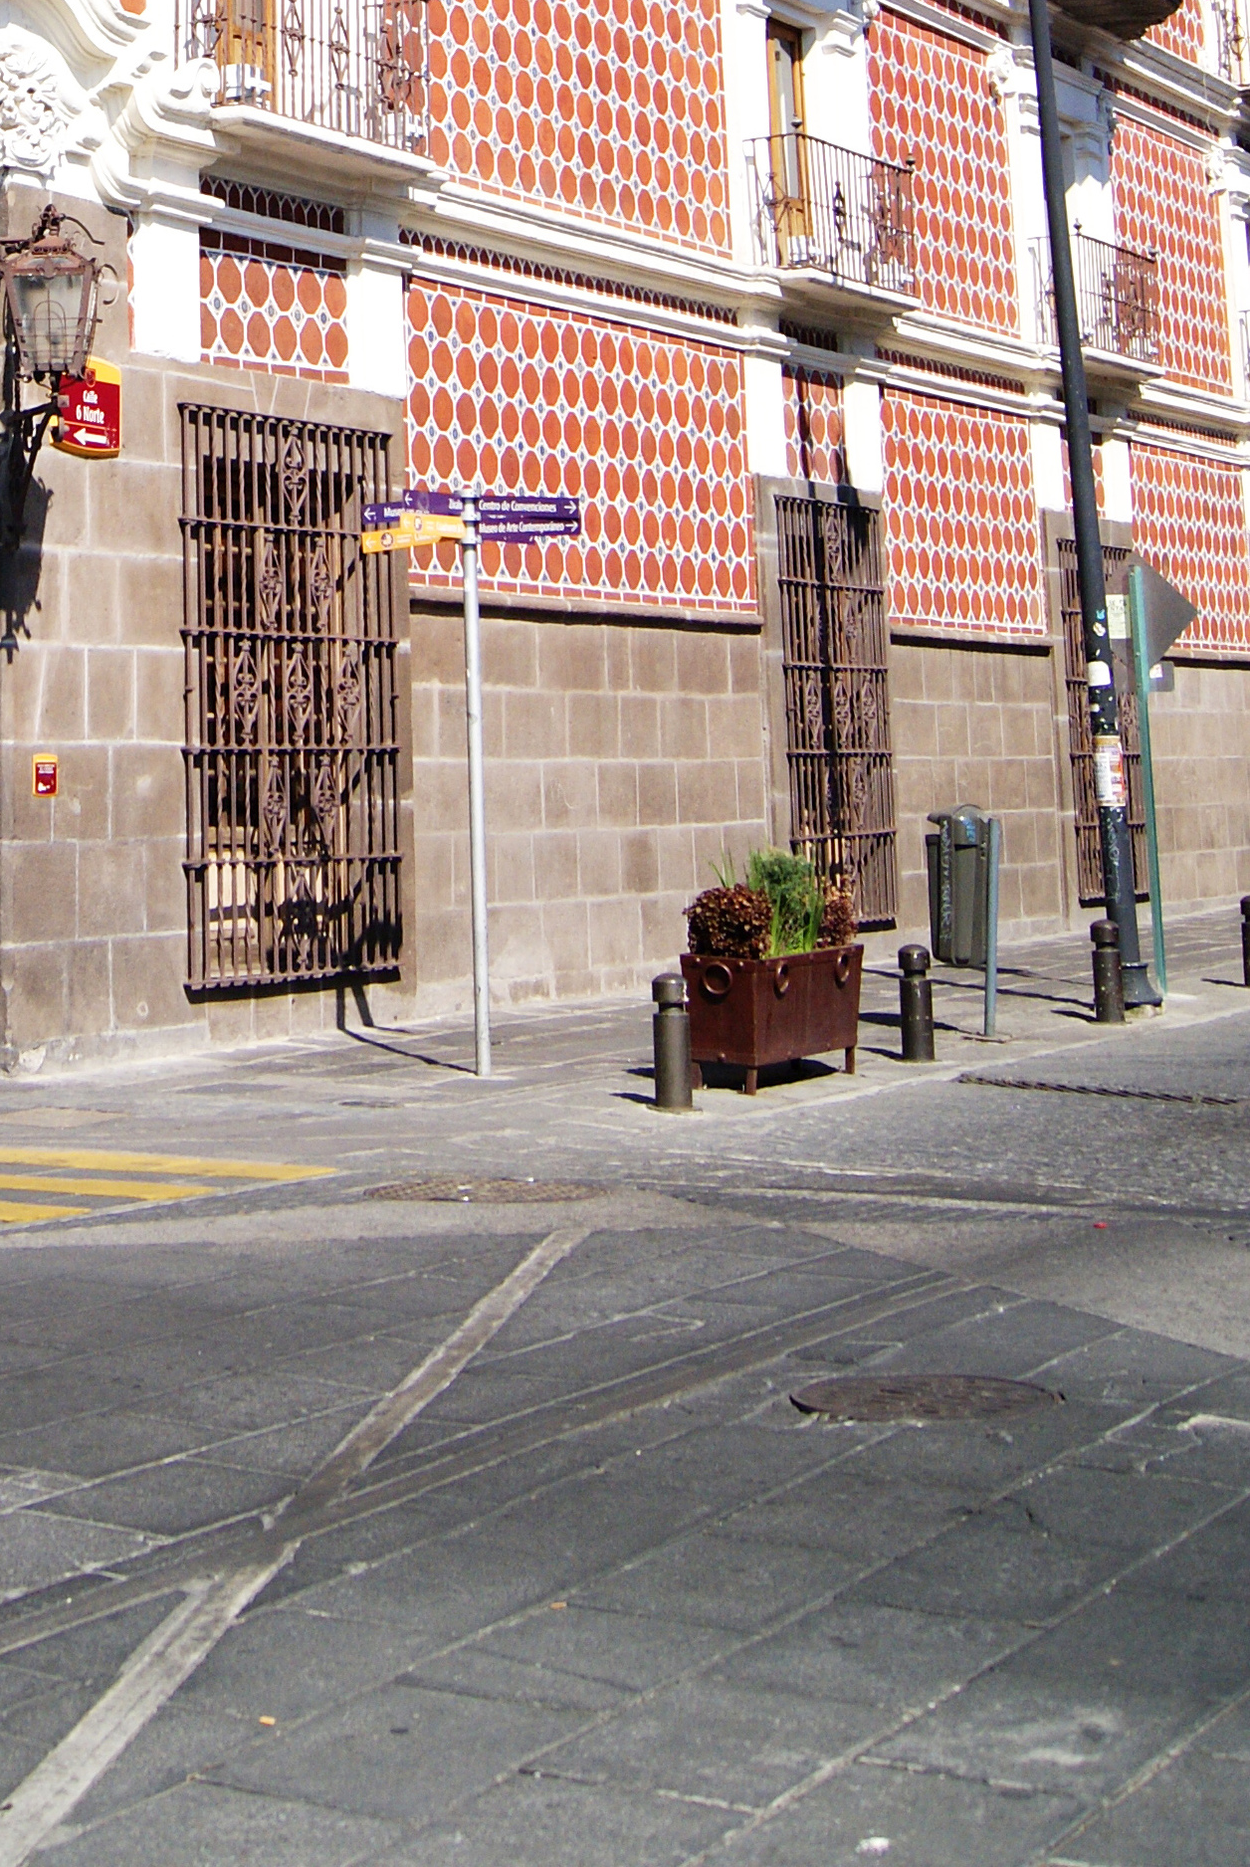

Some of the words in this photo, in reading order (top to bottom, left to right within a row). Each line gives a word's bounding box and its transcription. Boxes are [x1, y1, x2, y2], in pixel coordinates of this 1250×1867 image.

[76, 404, 82, 420] 6
[83, 405, 104, 424] Norte
[478, 499, 501, 511] Centro
[501, 500, 510, 511] de
[510, 500, 557, 512] Convenciones
[478, 522, 498, 534] Museo
[498, 521, 506, 533] de
[506, 521, 518, 533] Arte
